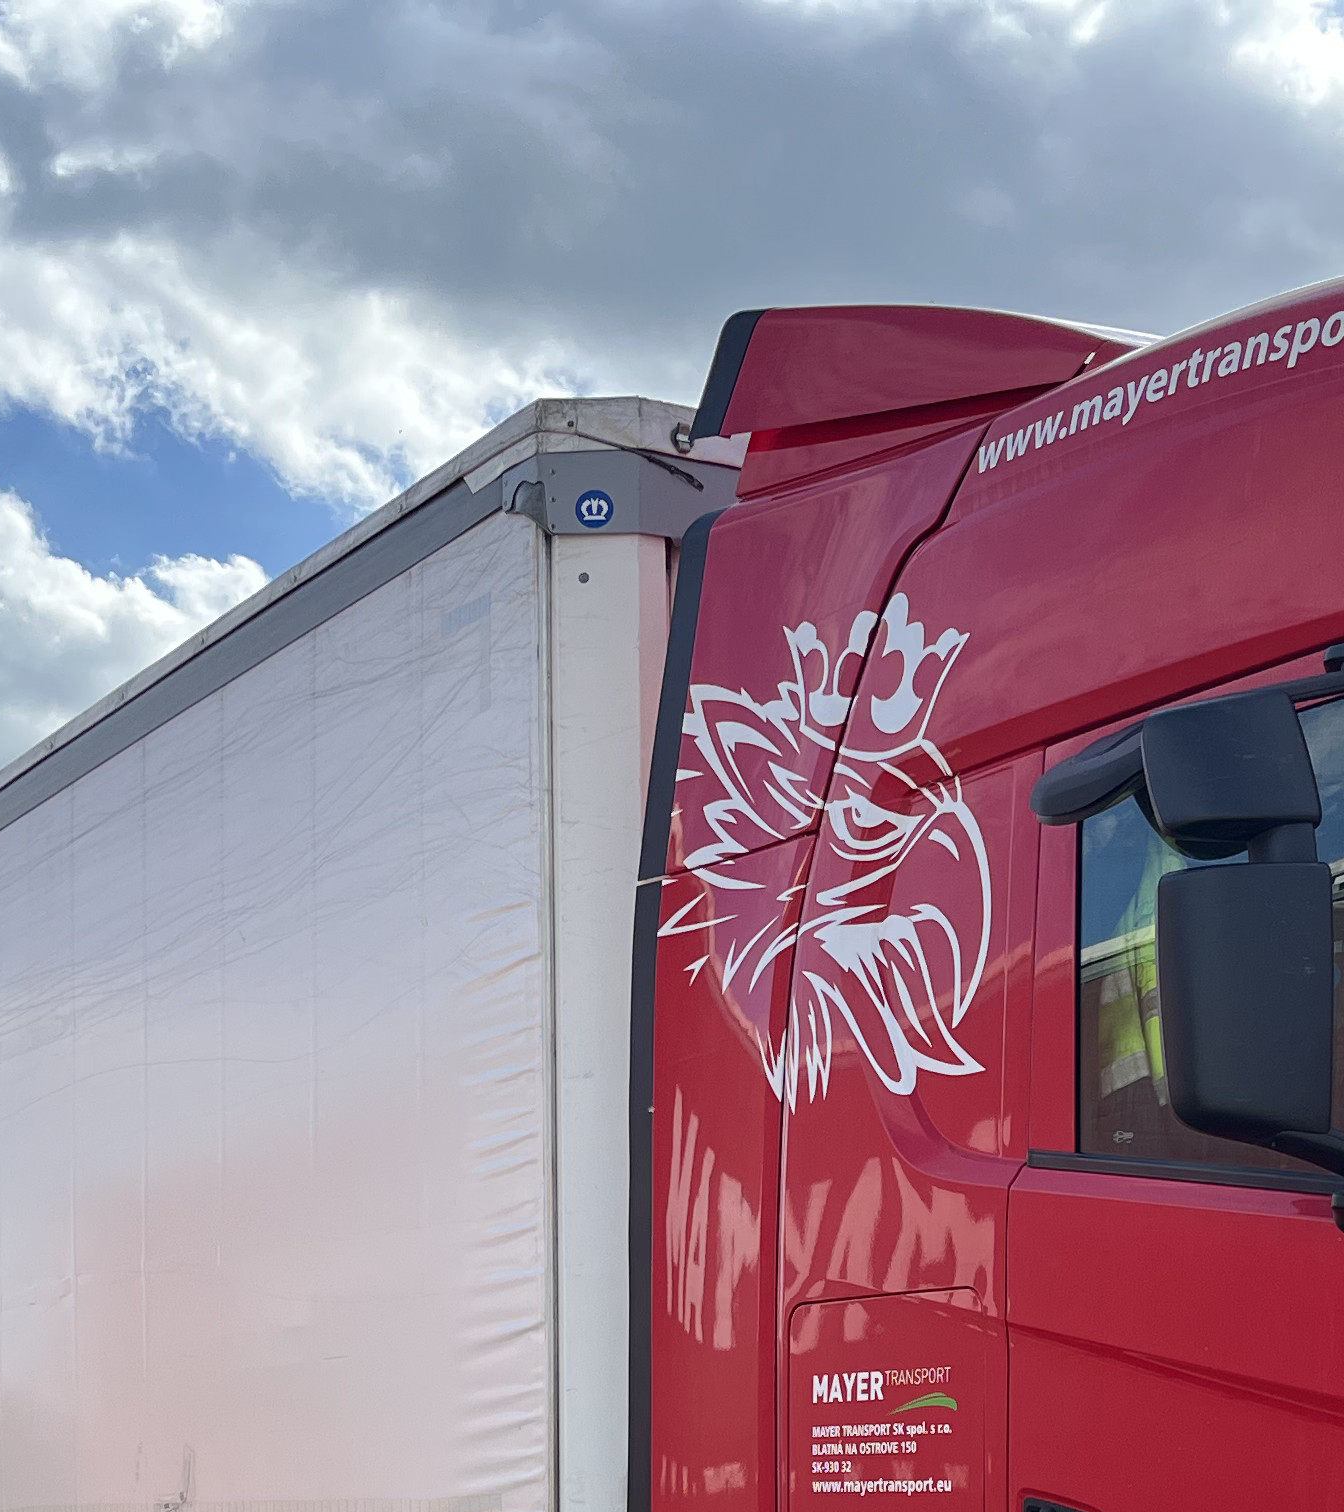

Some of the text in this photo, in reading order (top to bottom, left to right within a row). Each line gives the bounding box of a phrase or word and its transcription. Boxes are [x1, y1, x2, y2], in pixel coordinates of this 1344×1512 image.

[812, 1366, 952, 1404] MAYER TRANSPORT
[811, 1421, 953, 1438] MAYER TRANSPORT SK spol. s r.o.
[812, 1439, 917, 1456] BLATNÁ NA OSTROVE 150
[841, 1460, 852, 1473] 32
[812, 1476, 952, 1497] www.mayertransport.eu
